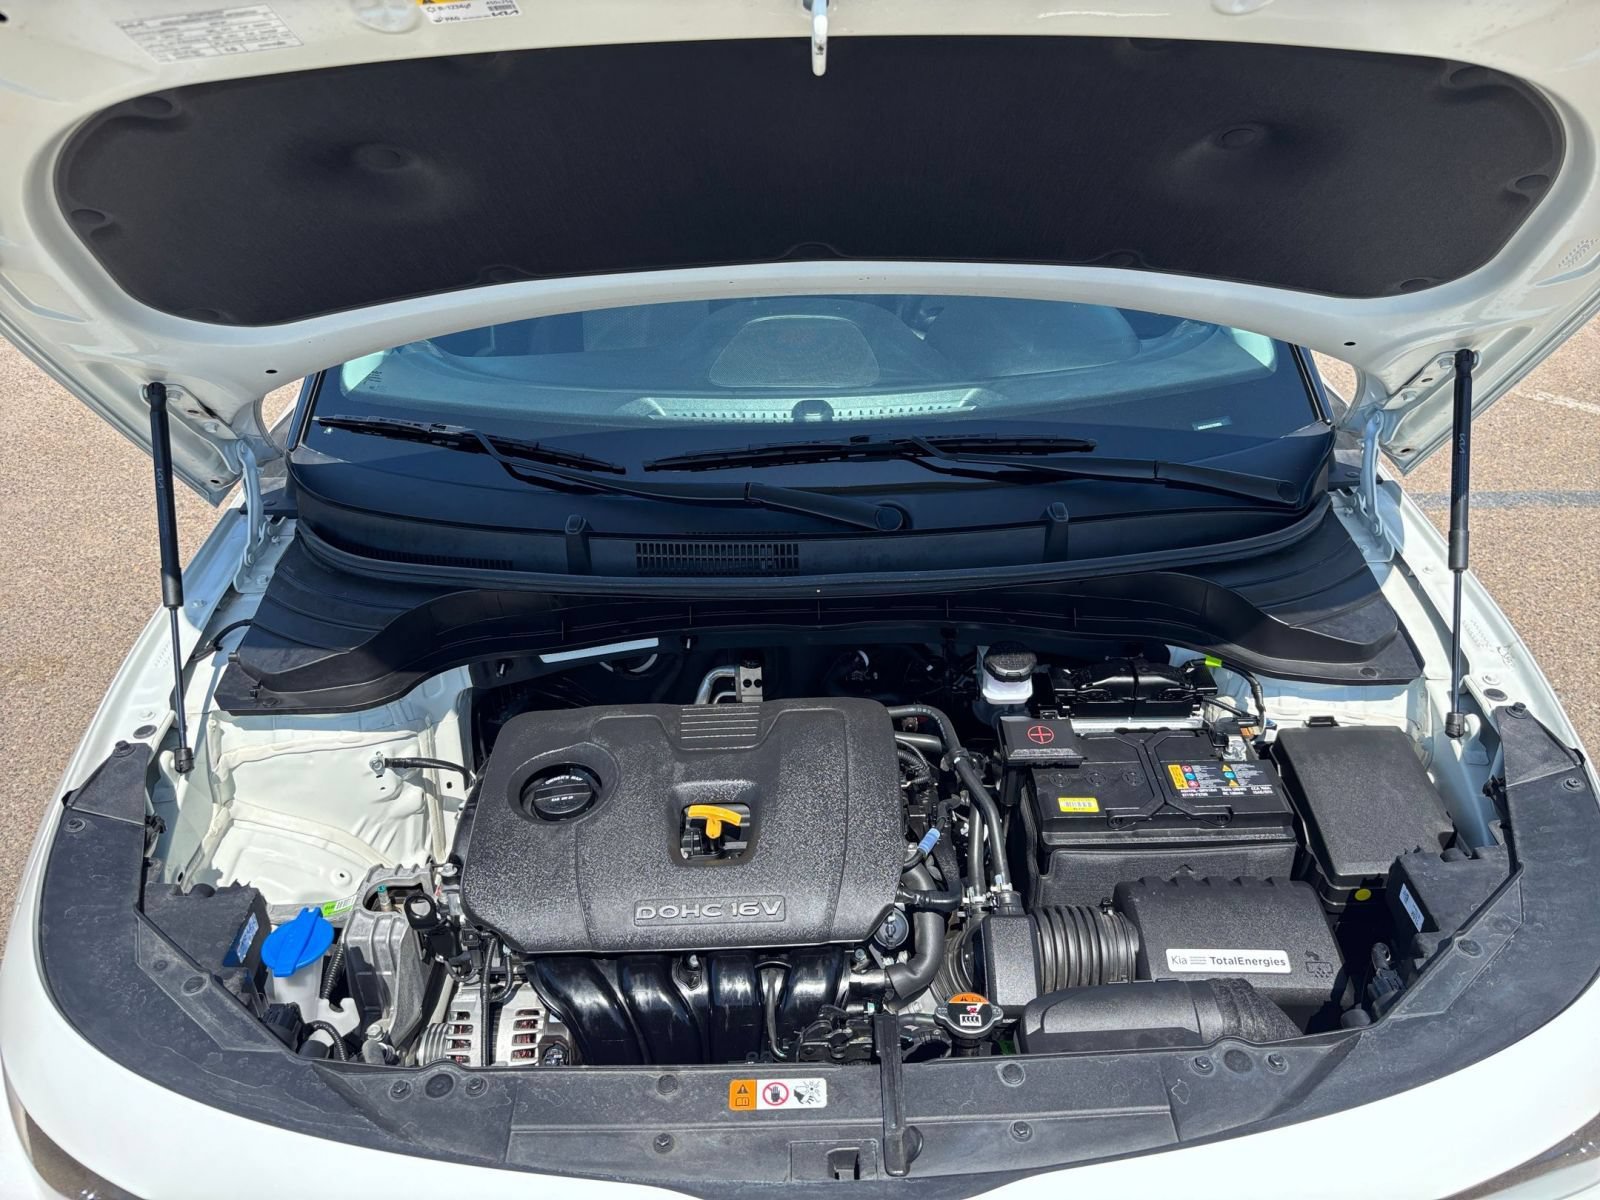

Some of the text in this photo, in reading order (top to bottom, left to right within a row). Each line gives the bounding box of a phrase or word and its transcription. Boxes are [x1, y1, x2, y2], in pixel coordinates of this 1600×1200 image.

[636, 900, 782, 920] DOHC 16V
[1171, 955, 1286, 968] Kia TotalEnergies
